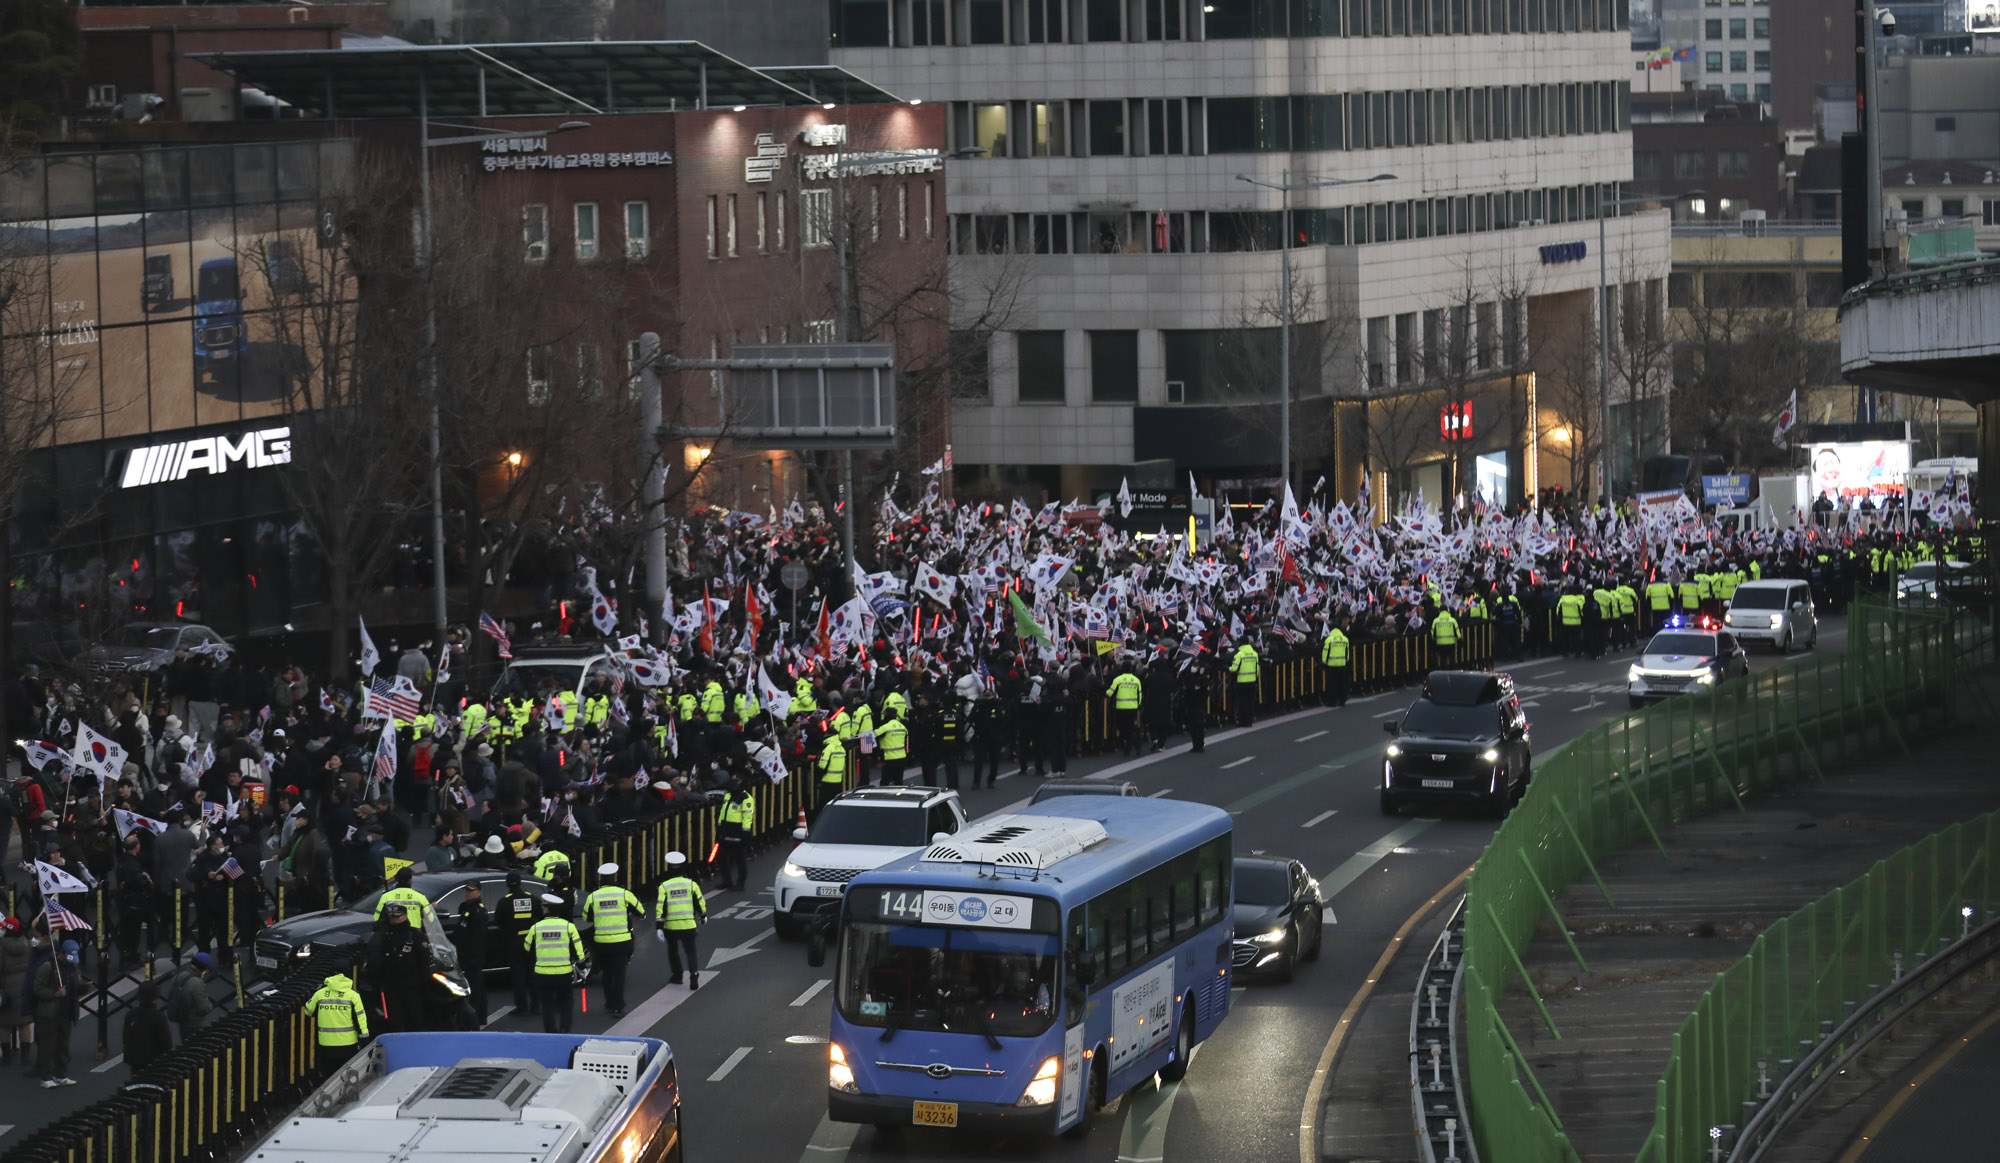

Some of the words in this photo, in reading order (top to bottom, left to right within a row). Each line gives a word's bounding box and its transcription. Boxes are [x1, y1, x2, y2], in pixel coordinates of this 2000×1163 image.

[482, 138, 547, 152] 서울특별시
[607, 151, 673, 167] 중부캠퍼스
[1539, 242, 1586, 264] VOLVO
[1139, 493, 1167, 502] Made
[880, 891, 922, 918] 144
[930, 902, 955, 913] 우이동
[960, 908, 985, 917] 역사공원
[916, 1110, 924, 1120] 사
[925, 1111, 954, 1124] 3236
